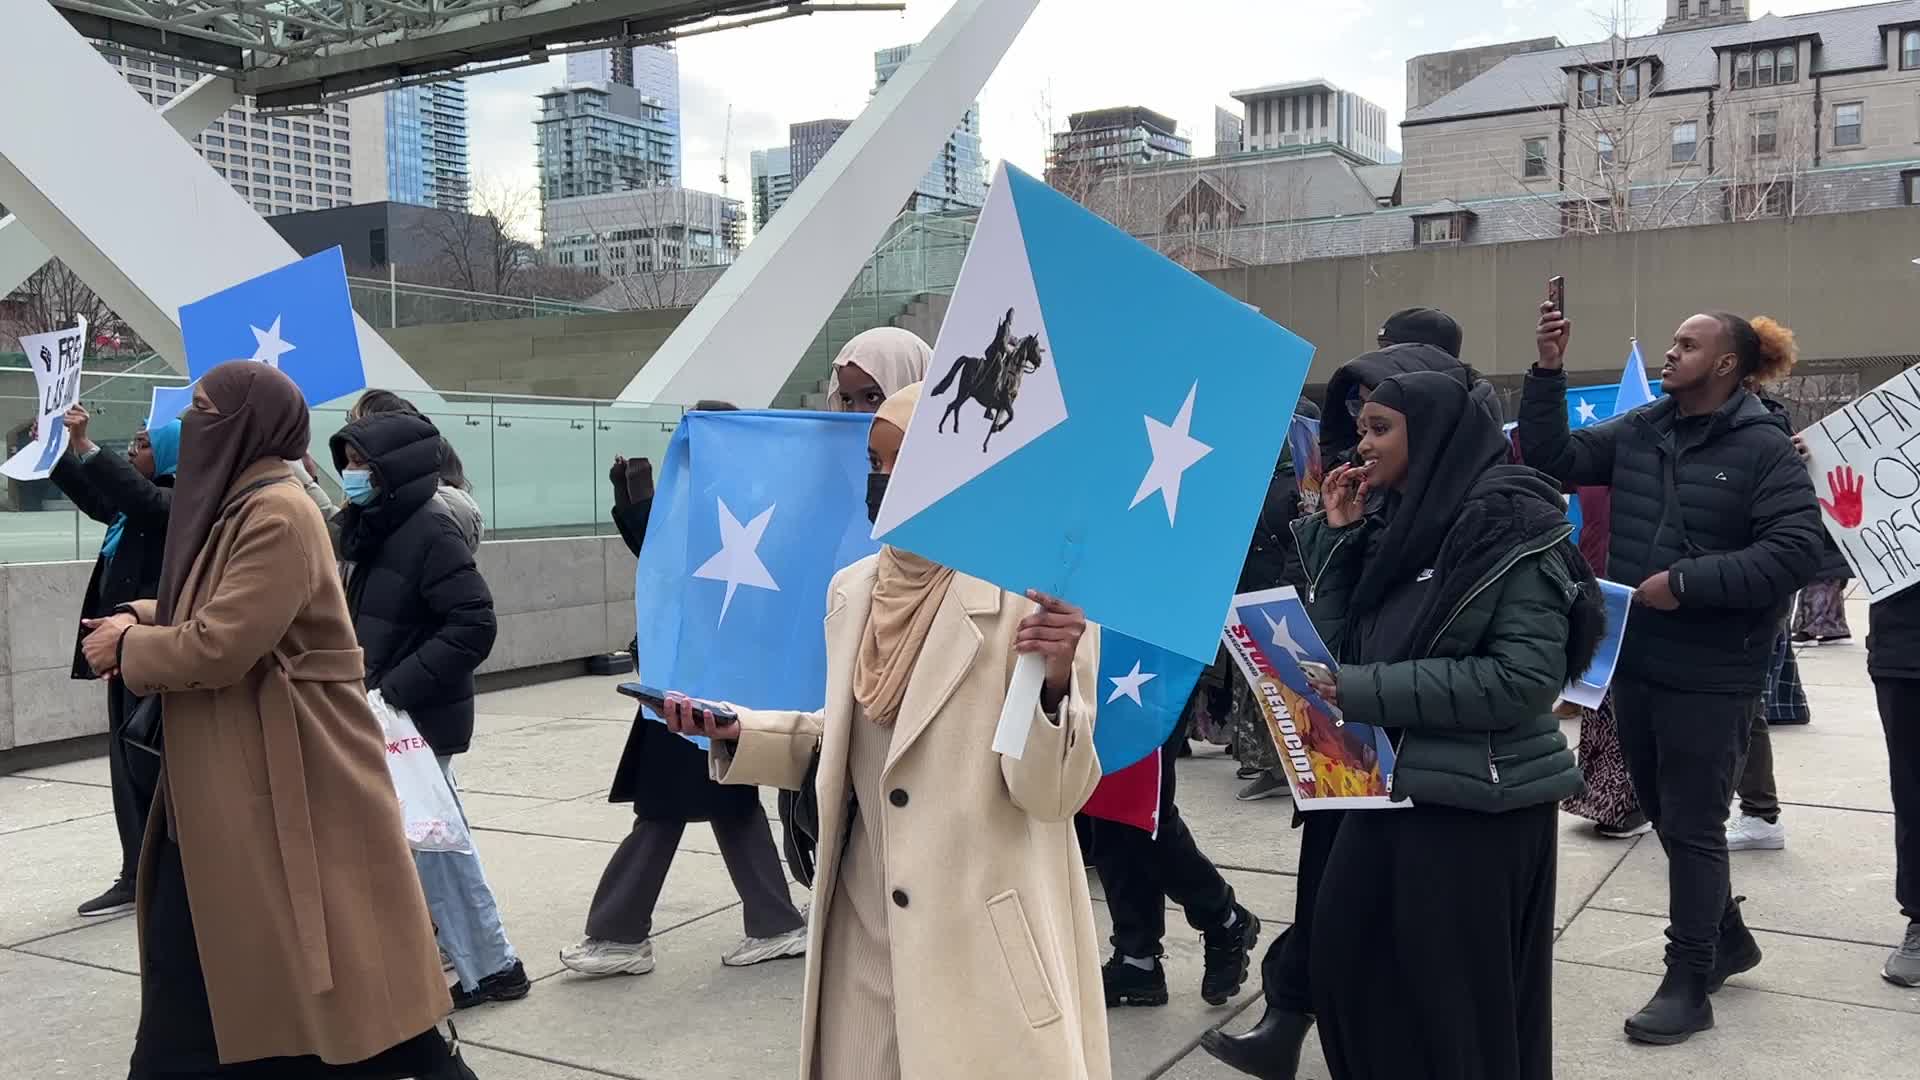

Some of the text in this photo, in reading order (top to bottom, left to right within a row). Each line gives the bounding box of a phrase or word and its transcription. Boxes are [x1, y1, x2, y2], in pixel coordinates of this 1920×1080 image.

[58, 334, 82, 375] FRE
[1820, 367, 1920, 463] HAN
[1842, 499, 1920, 595] LAAS
[1261, 682, 1316, 783] GENOCIDE
